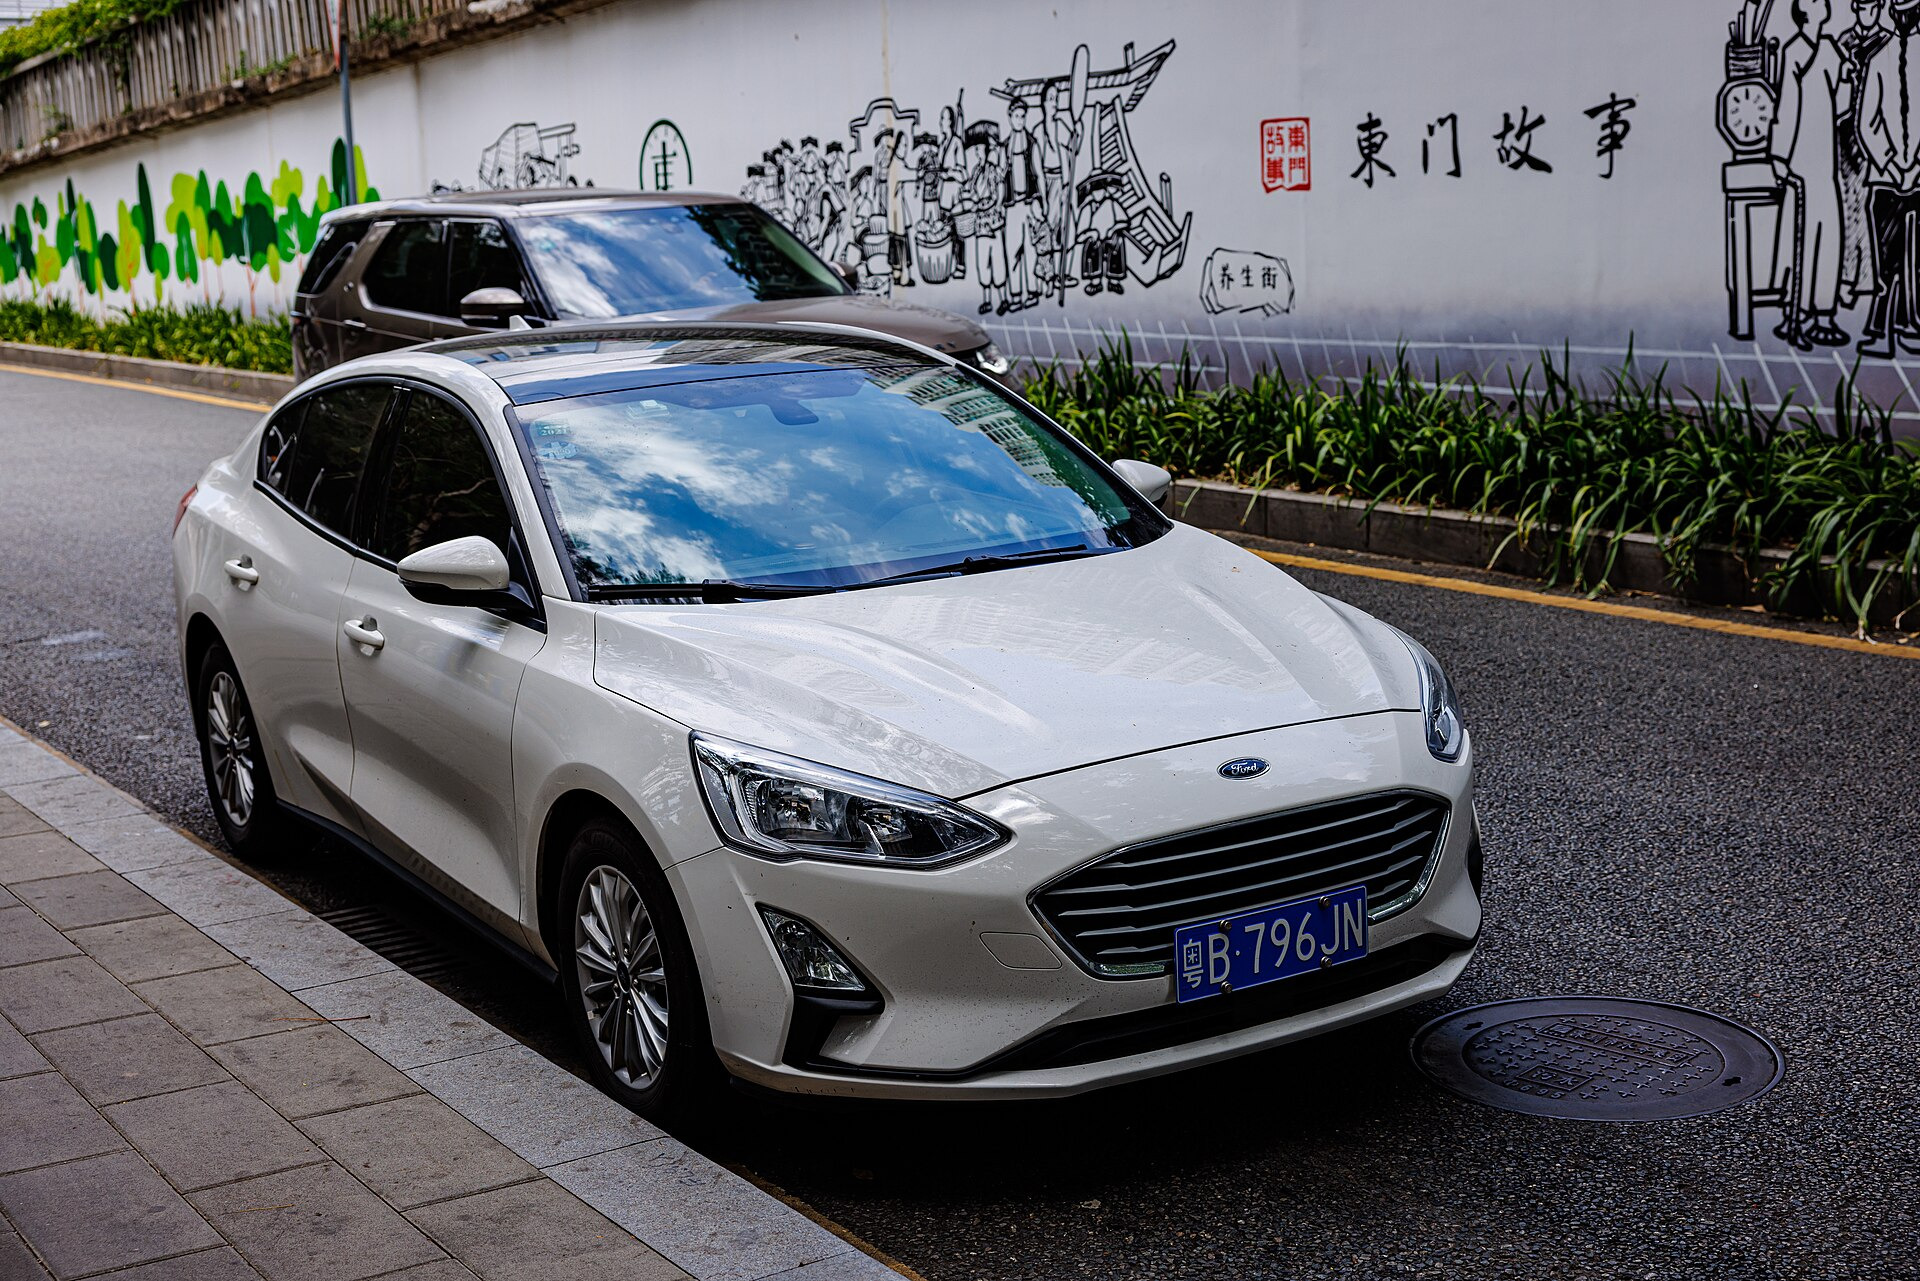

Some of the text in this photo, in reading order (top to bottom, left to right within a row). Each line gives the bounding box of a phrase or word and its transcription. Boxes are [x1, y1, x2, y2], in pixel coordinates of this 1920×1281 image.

[1221, 263, 1278, 290] 养生街
[1230, 762, 1257, 775] Ford
